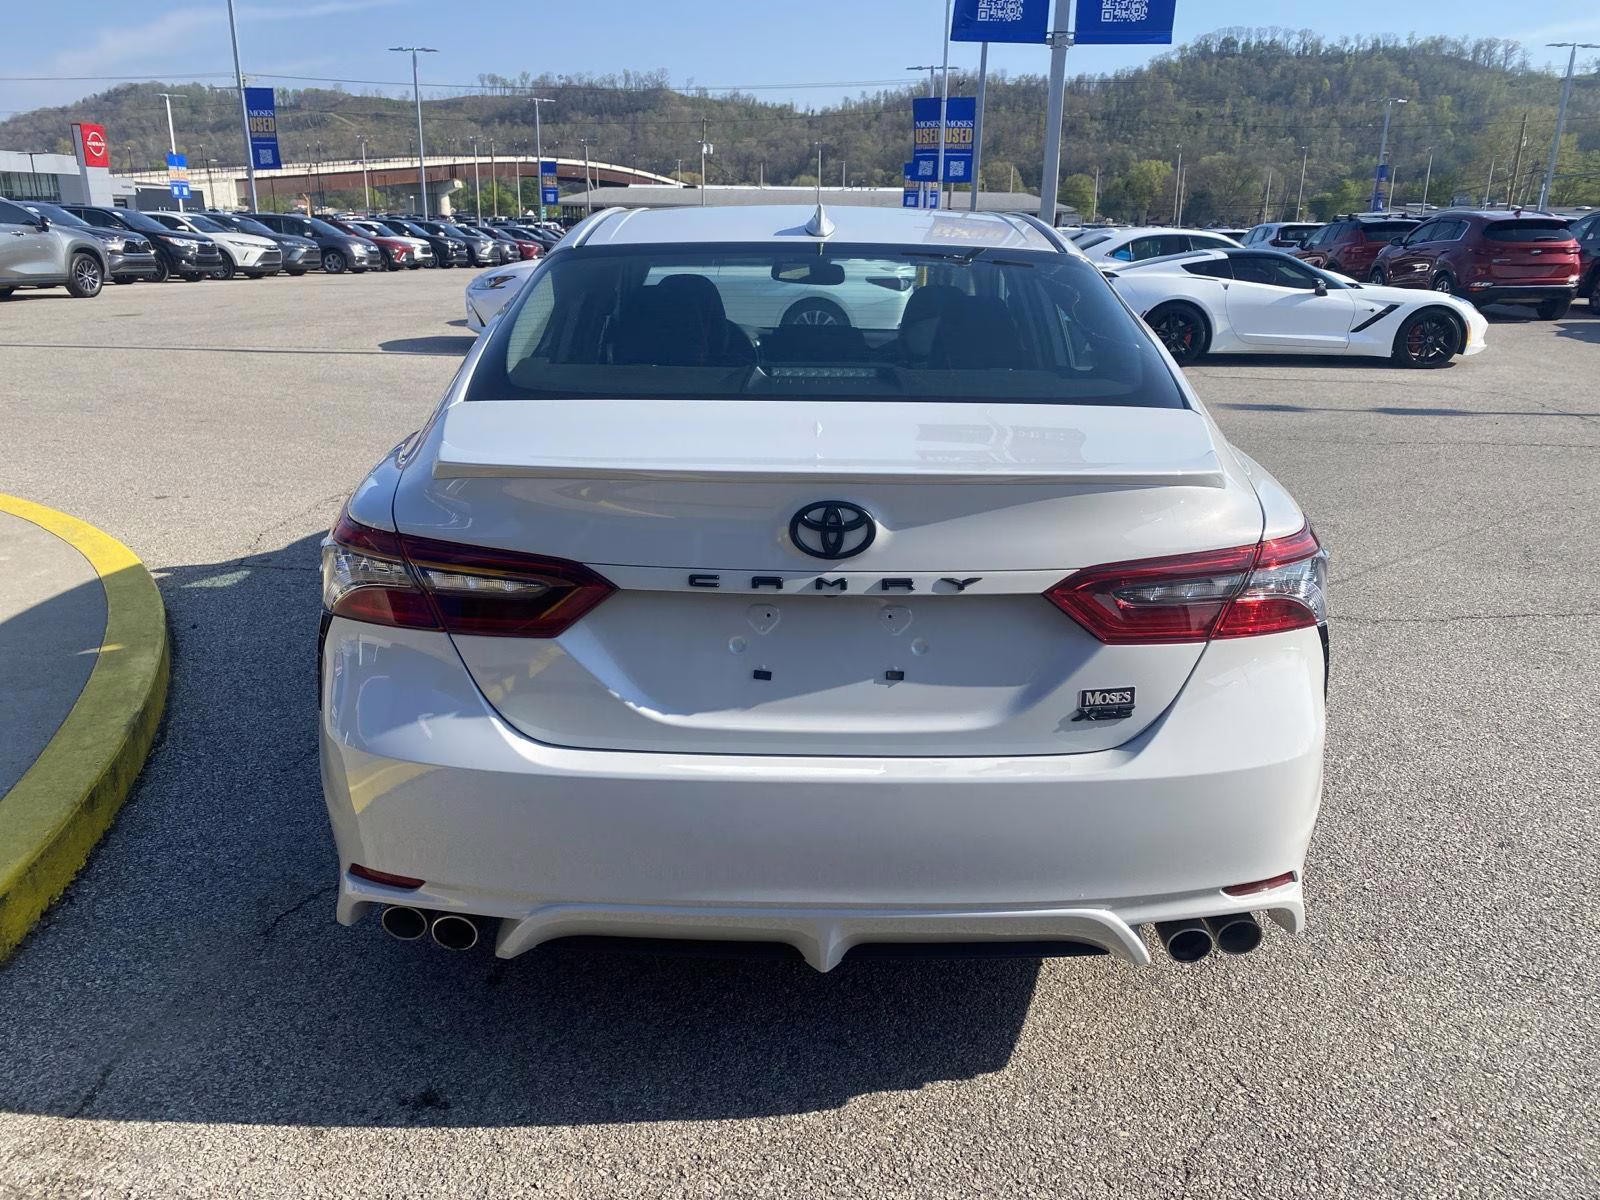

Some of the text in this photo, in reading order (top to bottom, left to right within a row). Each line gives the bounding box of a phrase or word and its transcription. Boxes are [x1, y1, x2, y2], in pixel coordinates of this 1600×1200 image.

[249, 109, 273, 117] MOSES
[250, 117, 275, 132] USED
[945, 128, 973, 143] USED
[688, 574, 983, 590] CAMRY
[1085, 691, 1131, 705] MOSES
